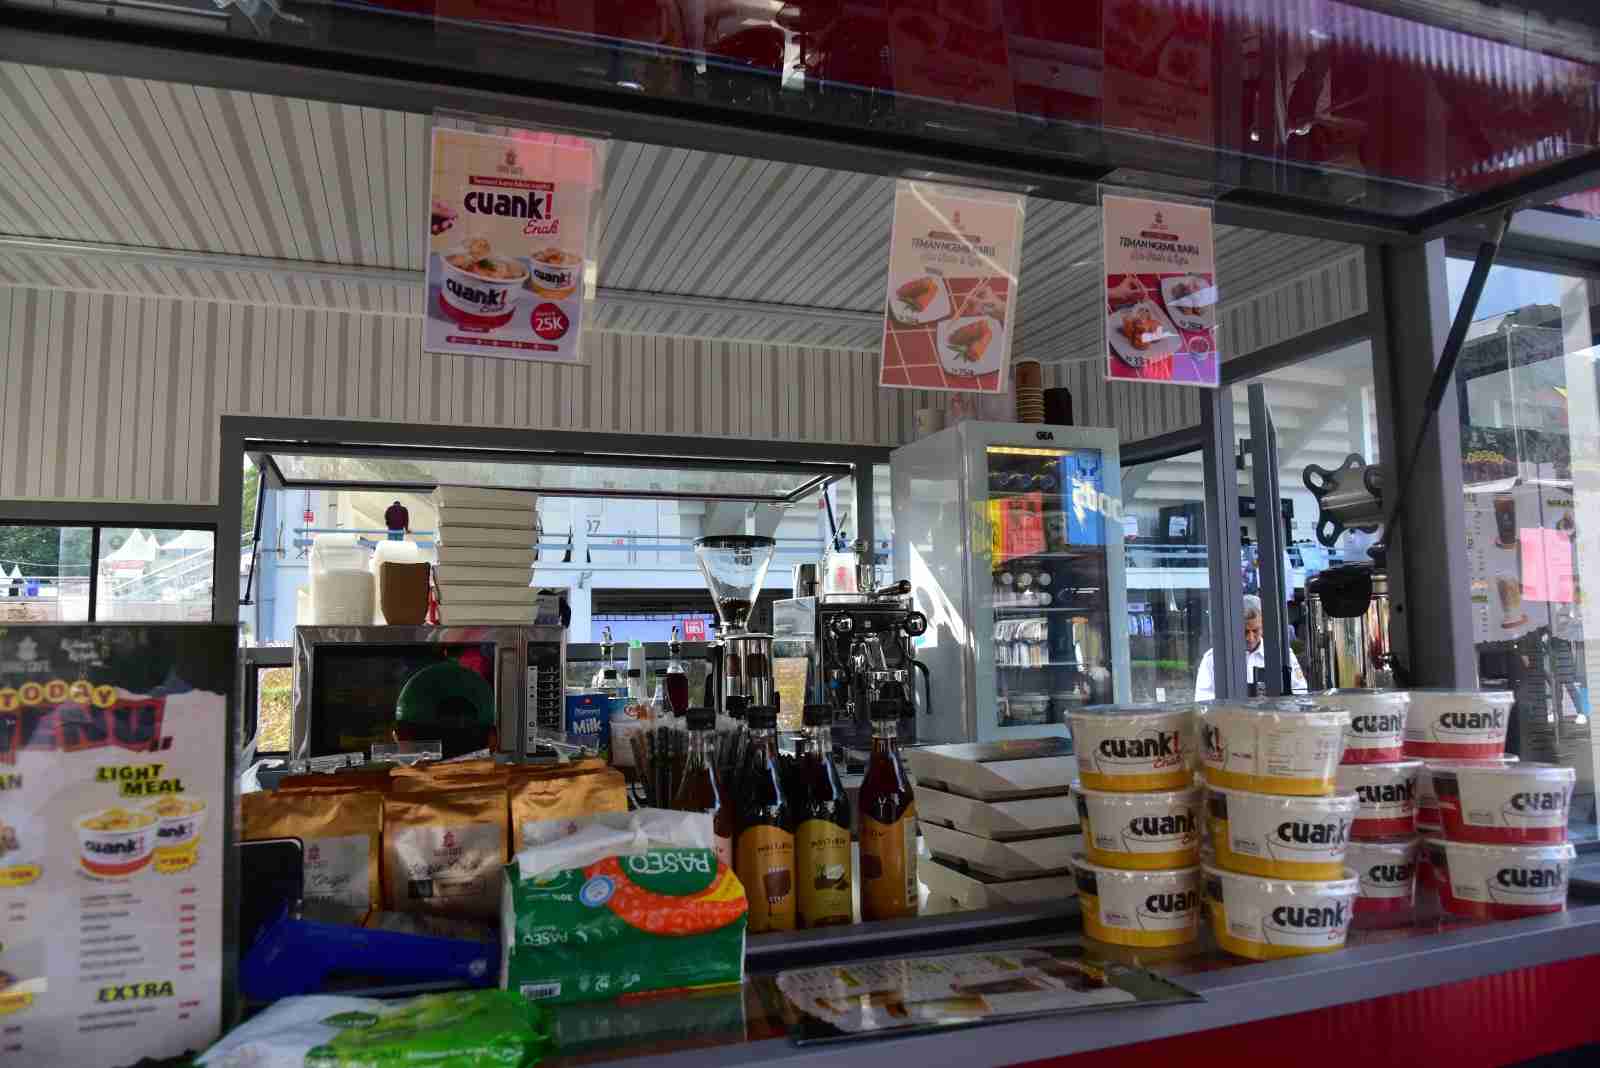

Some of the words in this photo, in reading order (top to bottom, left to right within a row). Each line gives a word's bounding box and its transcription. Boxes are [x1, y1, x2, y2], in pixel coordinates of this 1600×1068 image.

[464, 191, 553, 220] cuank!
[523, 218, 560, 235] Enak
[446, 278, 508, 306] cuank!
[535, 316, 564, 332] 25K
[1036, 431, 1054, 441] GEA
[573, 717, 602, 736] Milk
[1100, 731, 1180, 759] cuank!
[97, 764, 163, 782] LIGHT
[122, 778, 184, 796] MEAL
[628, 852, 711, 873] PASEO
[98, 981, 174, 1004] EXTRA
